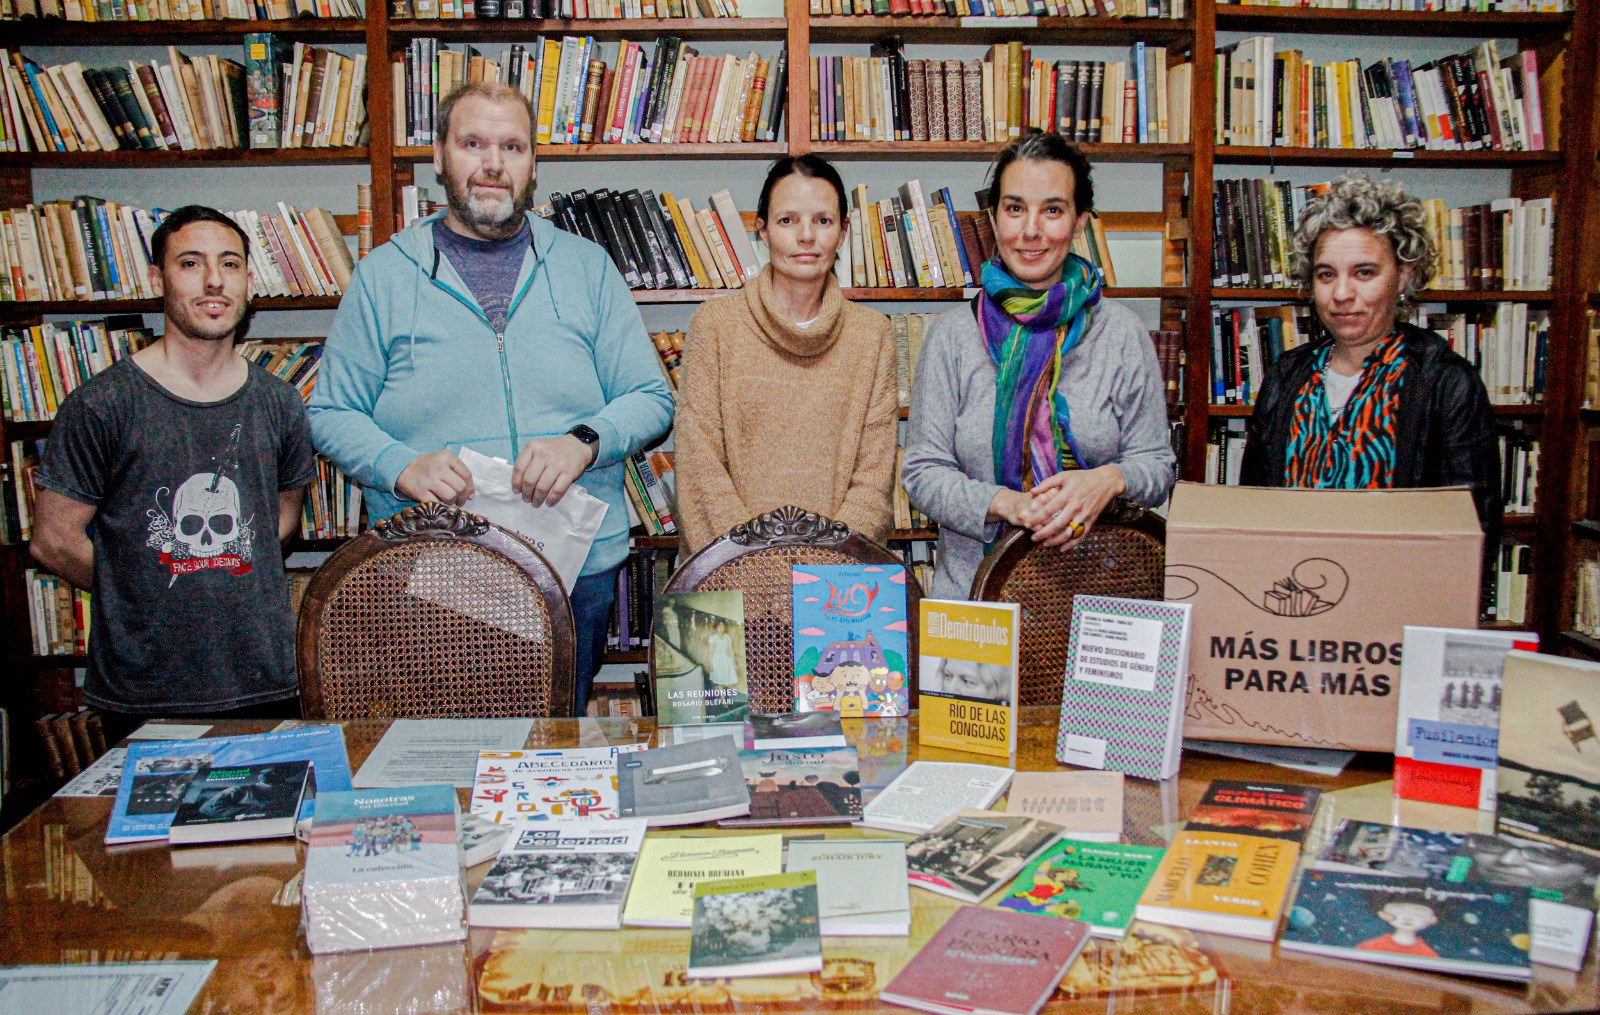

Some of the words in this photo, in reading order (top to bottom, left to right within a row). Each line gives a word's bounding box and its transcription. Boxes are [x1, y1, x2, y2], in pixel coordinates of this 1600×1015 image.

[86, 248, 100, 274] Española
[173, 562, 192, 572] FACE
[823, 580, 879, 611] LUCY
[940, 613, 1008, 648] Demitrópulos
[1210, 631, 1279, 660] MÁS
[1081, 644, 1103, 653] NUEVO
[1105, 648, 1145, 660] DICCIONARIO
[1089, 656, 1118, 667] ESTUDIOS
[1130, 661, 1154, 673] GÉNERO
[1079, 666, 1083, 674] Y
[1085, 667, 1123, 679] FEMINISMOS
[1225, 668, 1309, 694] PARA
[1321, 667, 1391, 697] MÁS
[667, 690, 684, 699] LAS
[687, 688, 738, 698] REUNIONES
[705, 697, 734, 706] BLÉFARI
[950, 702, 966, 719] RÍO
[970, 706, 982, 721] DE
[986, 708, 1005, 725] LAS
[950, 720, 1005, 742] CONGOJAS
[762, 752, 825, 764] Justo
[518, 760, 613, 769] ABECEDARIO
[354, 795, 415, 806] Nosotras
[1214, 793, 1305, 810] CLIMÁTICO
[523, 830, 559, 838] Los
[518, 836, 627, 845] Oesterheld
[1186, 838, 1239, 847] LLANTO
[366, 863, 413, 872] colección
[1247, 845, 1279, 886] COHEN
[708, 869, 745, 877] BRUMANA
[1213, 895, 1261, 907] VERDE
